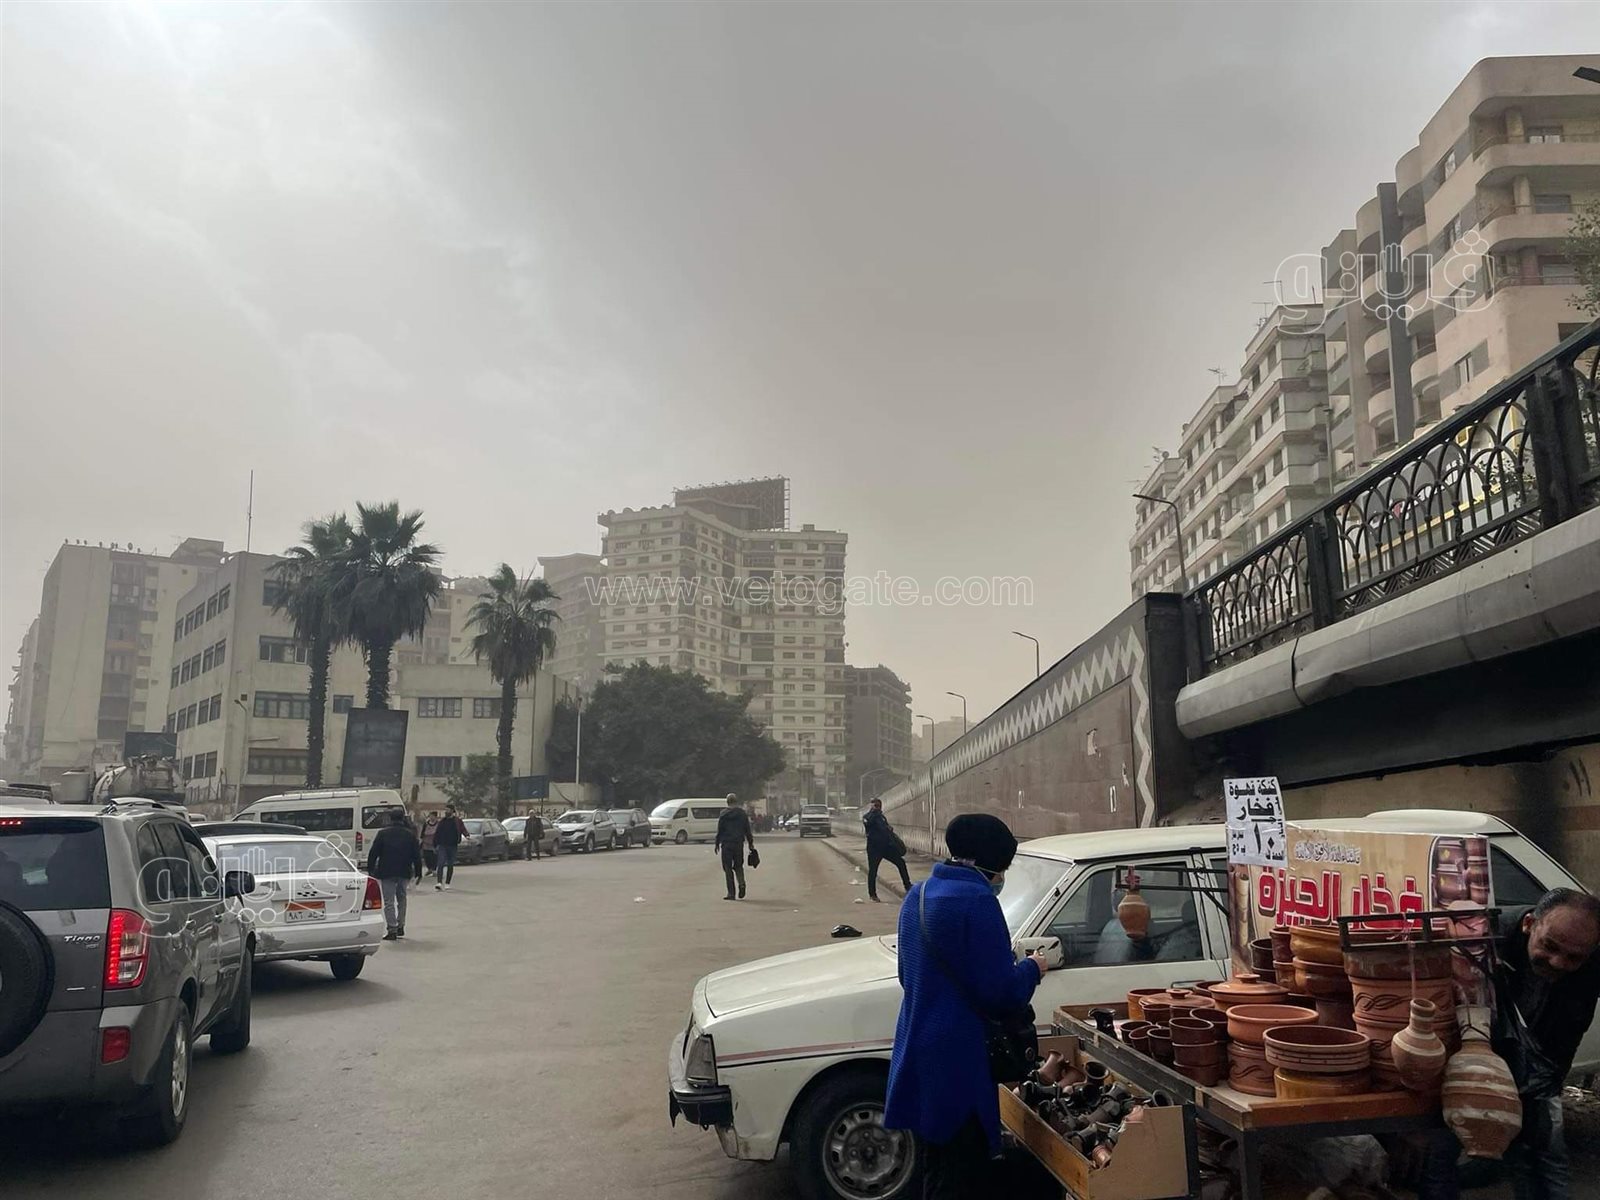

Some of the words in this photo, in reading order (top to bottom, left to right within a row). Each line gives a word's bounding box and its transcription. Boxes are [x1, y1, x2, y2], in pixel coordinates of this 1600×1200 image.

[1229, 780, 1256, 799] قهوة
[1236, 798, 1275, 820] فخار
[1258, 865, 1341, 928] الجيزة
[1348, 873, 1424, 930] فخار
